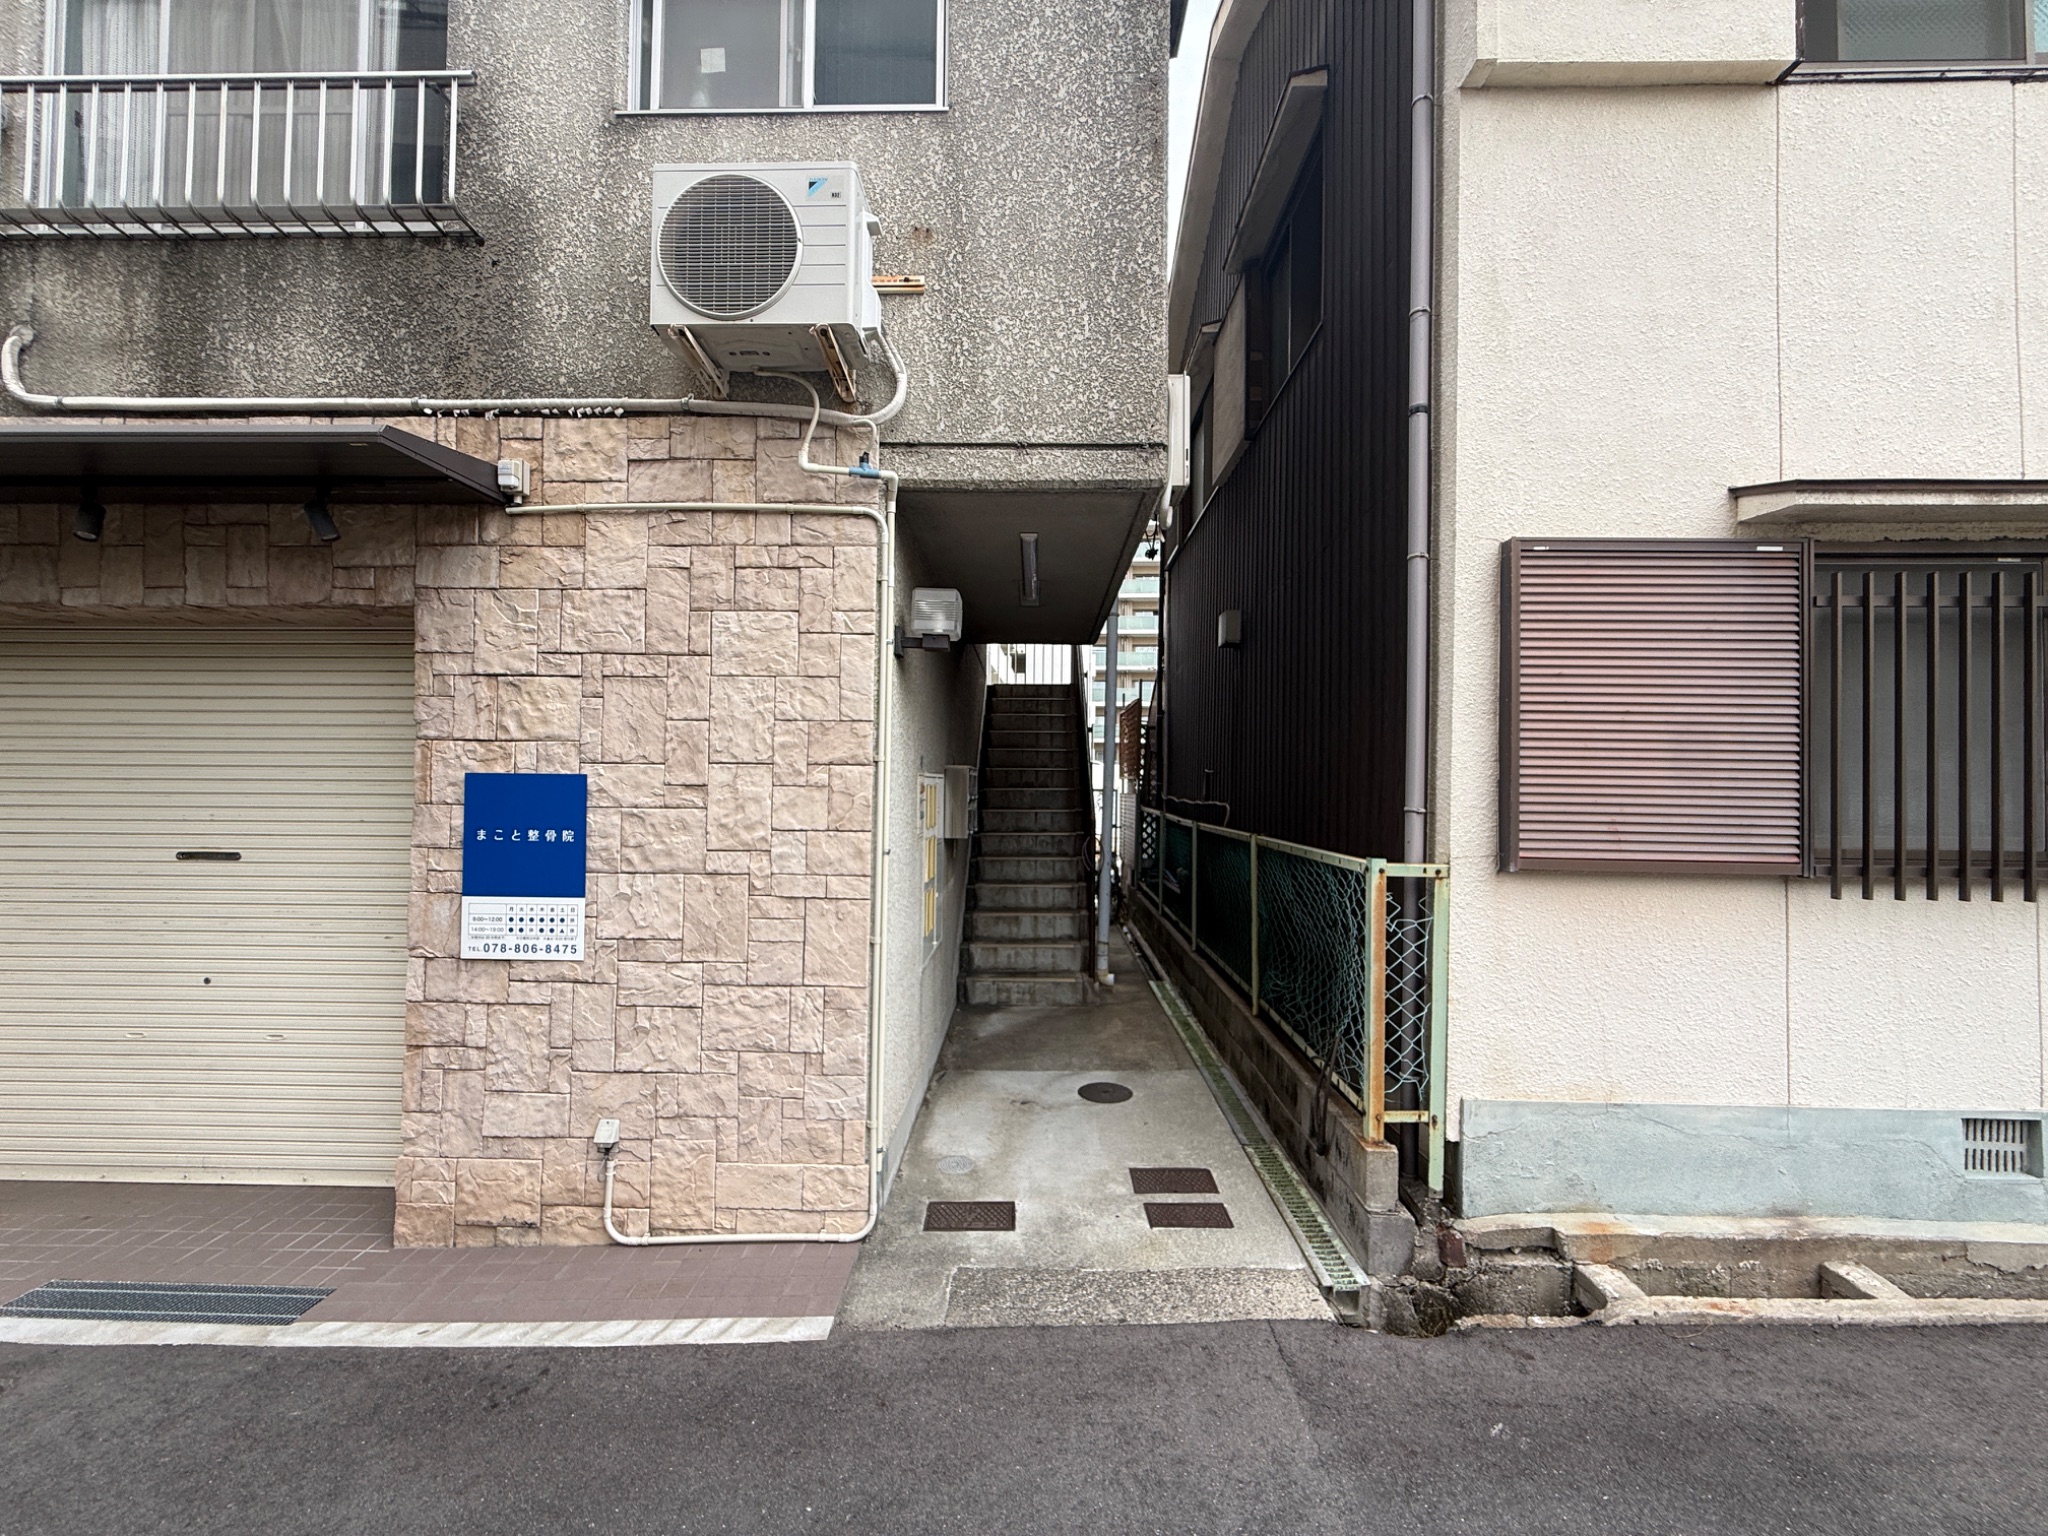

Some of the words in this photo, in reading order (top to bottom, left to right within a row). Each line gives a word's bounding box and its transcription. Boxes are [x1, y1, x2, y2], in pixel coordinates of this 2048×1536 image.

[476, 829, 575, 842] まこと整骨院
